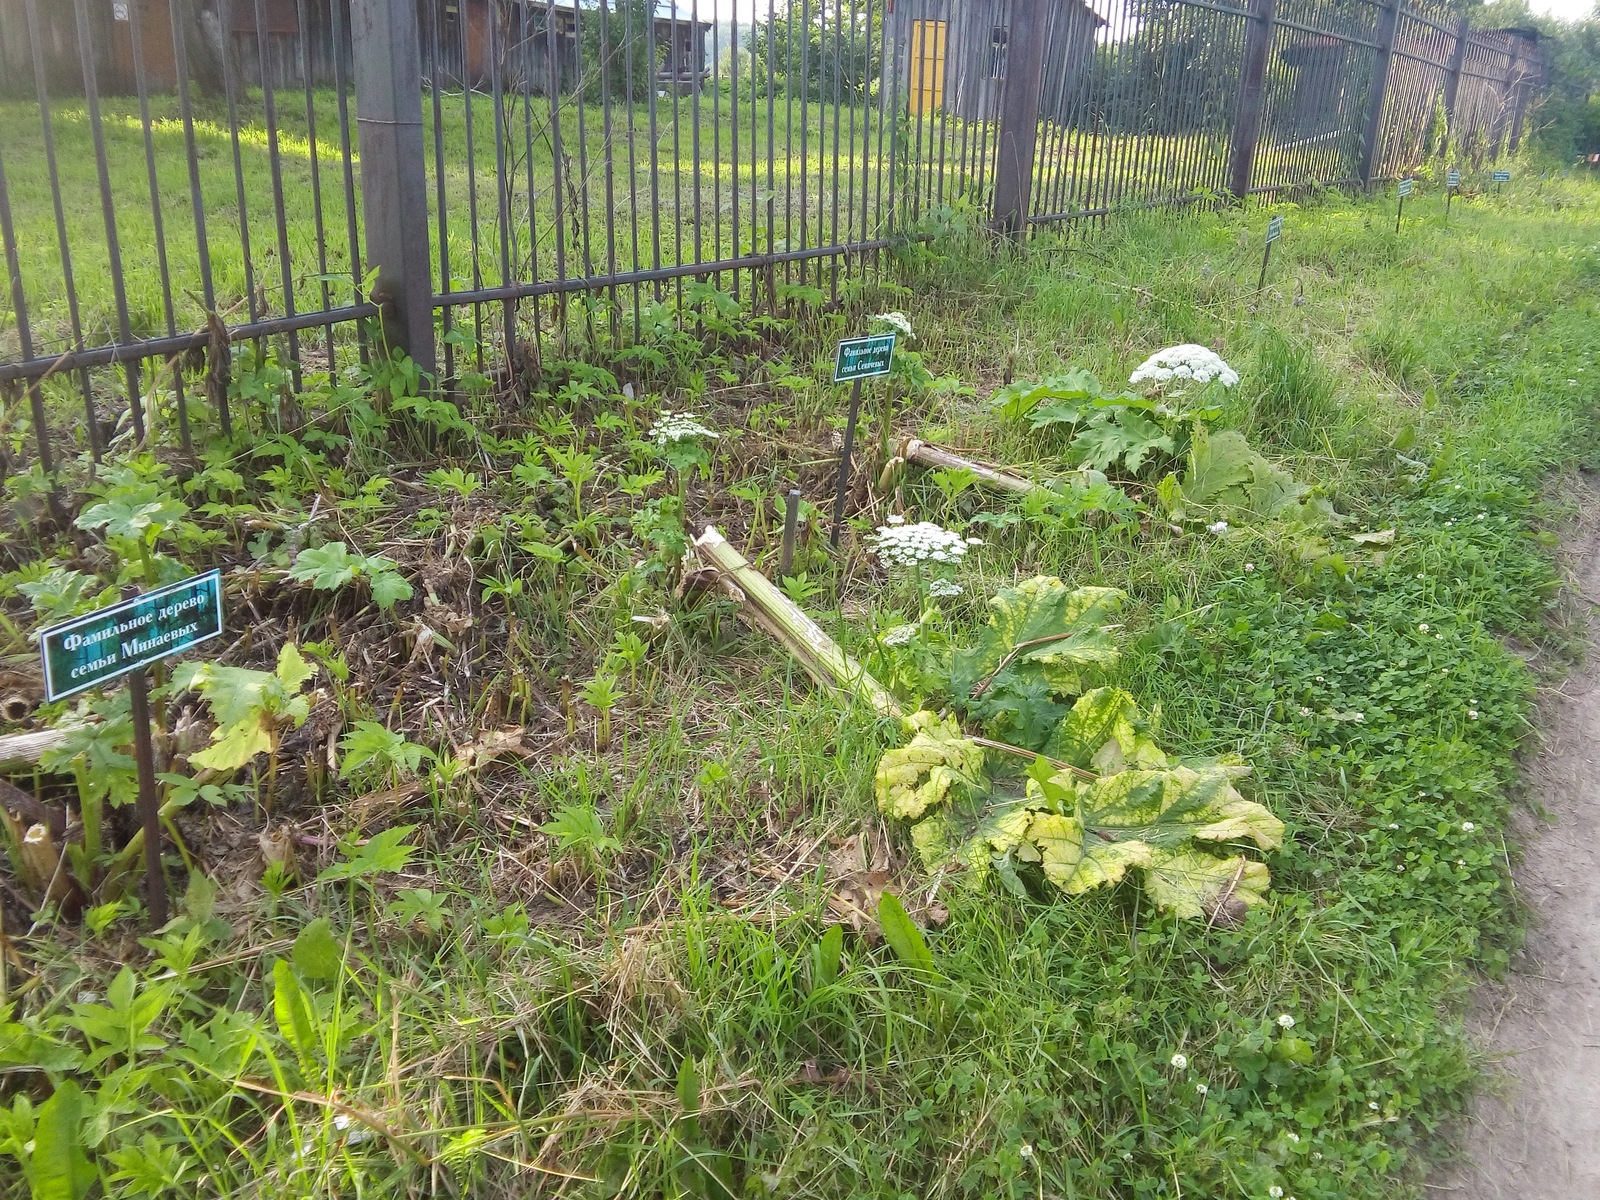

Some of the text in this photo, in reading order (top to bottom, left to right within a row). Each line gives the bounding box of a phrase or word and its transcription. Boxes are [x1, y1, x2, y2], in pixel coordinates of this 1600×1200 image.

[63, 594, 205, 652] Фамильное дерево
[70, 622, 198, 679] семьи Минаевых
